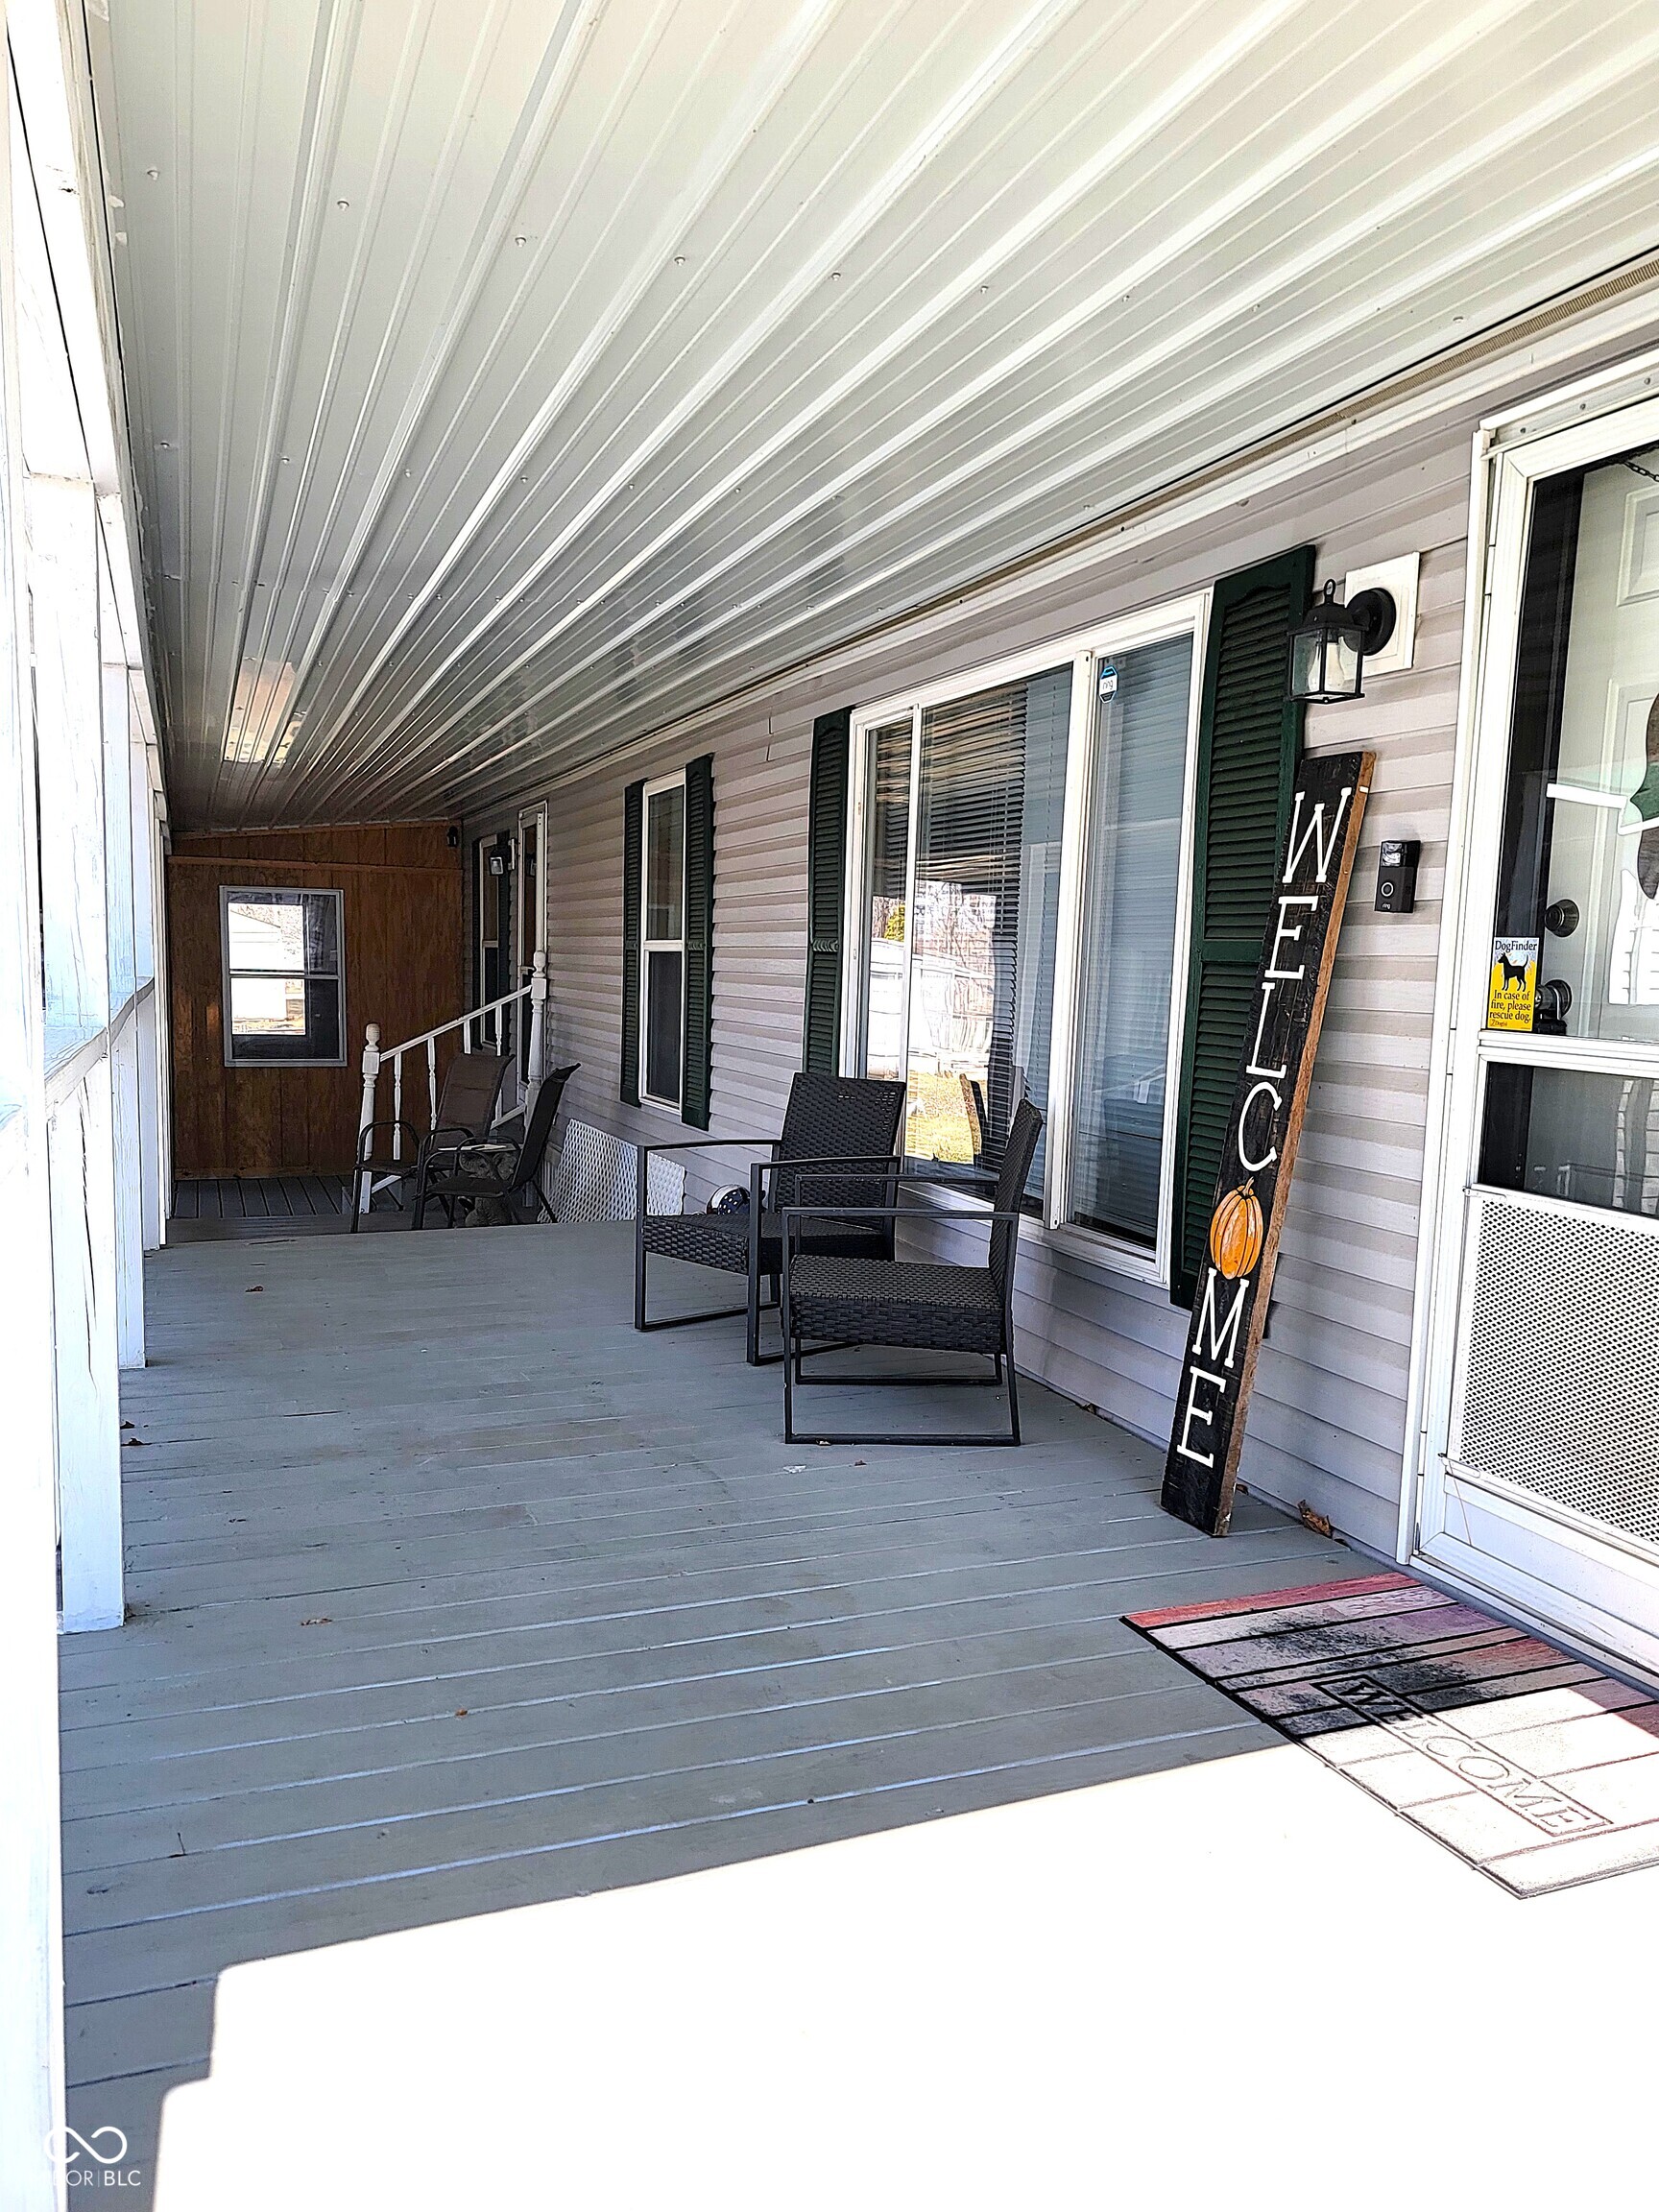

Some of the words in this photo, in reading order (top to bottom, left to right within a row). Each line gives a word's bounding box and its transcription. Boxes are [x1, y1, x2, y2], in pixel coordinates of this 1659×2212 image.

[1495, 941, 1537, 952] DogFinder
[1494, 990, 1502, 999] In
[1503, 992, 1520, 1000] case
[1522, 990, 1530, 1000] of
[1491, 999, 1505, 1011] fire,
[1507, 999, 1531, 1012] please
[1489, 1011, 1513, 1020] rescue
[1515, 1011, 1531, 1023] dog.
[1176, 785, 1351, 1469] WELCME
[1338, 1681, 1591, 1828] WELCOME
